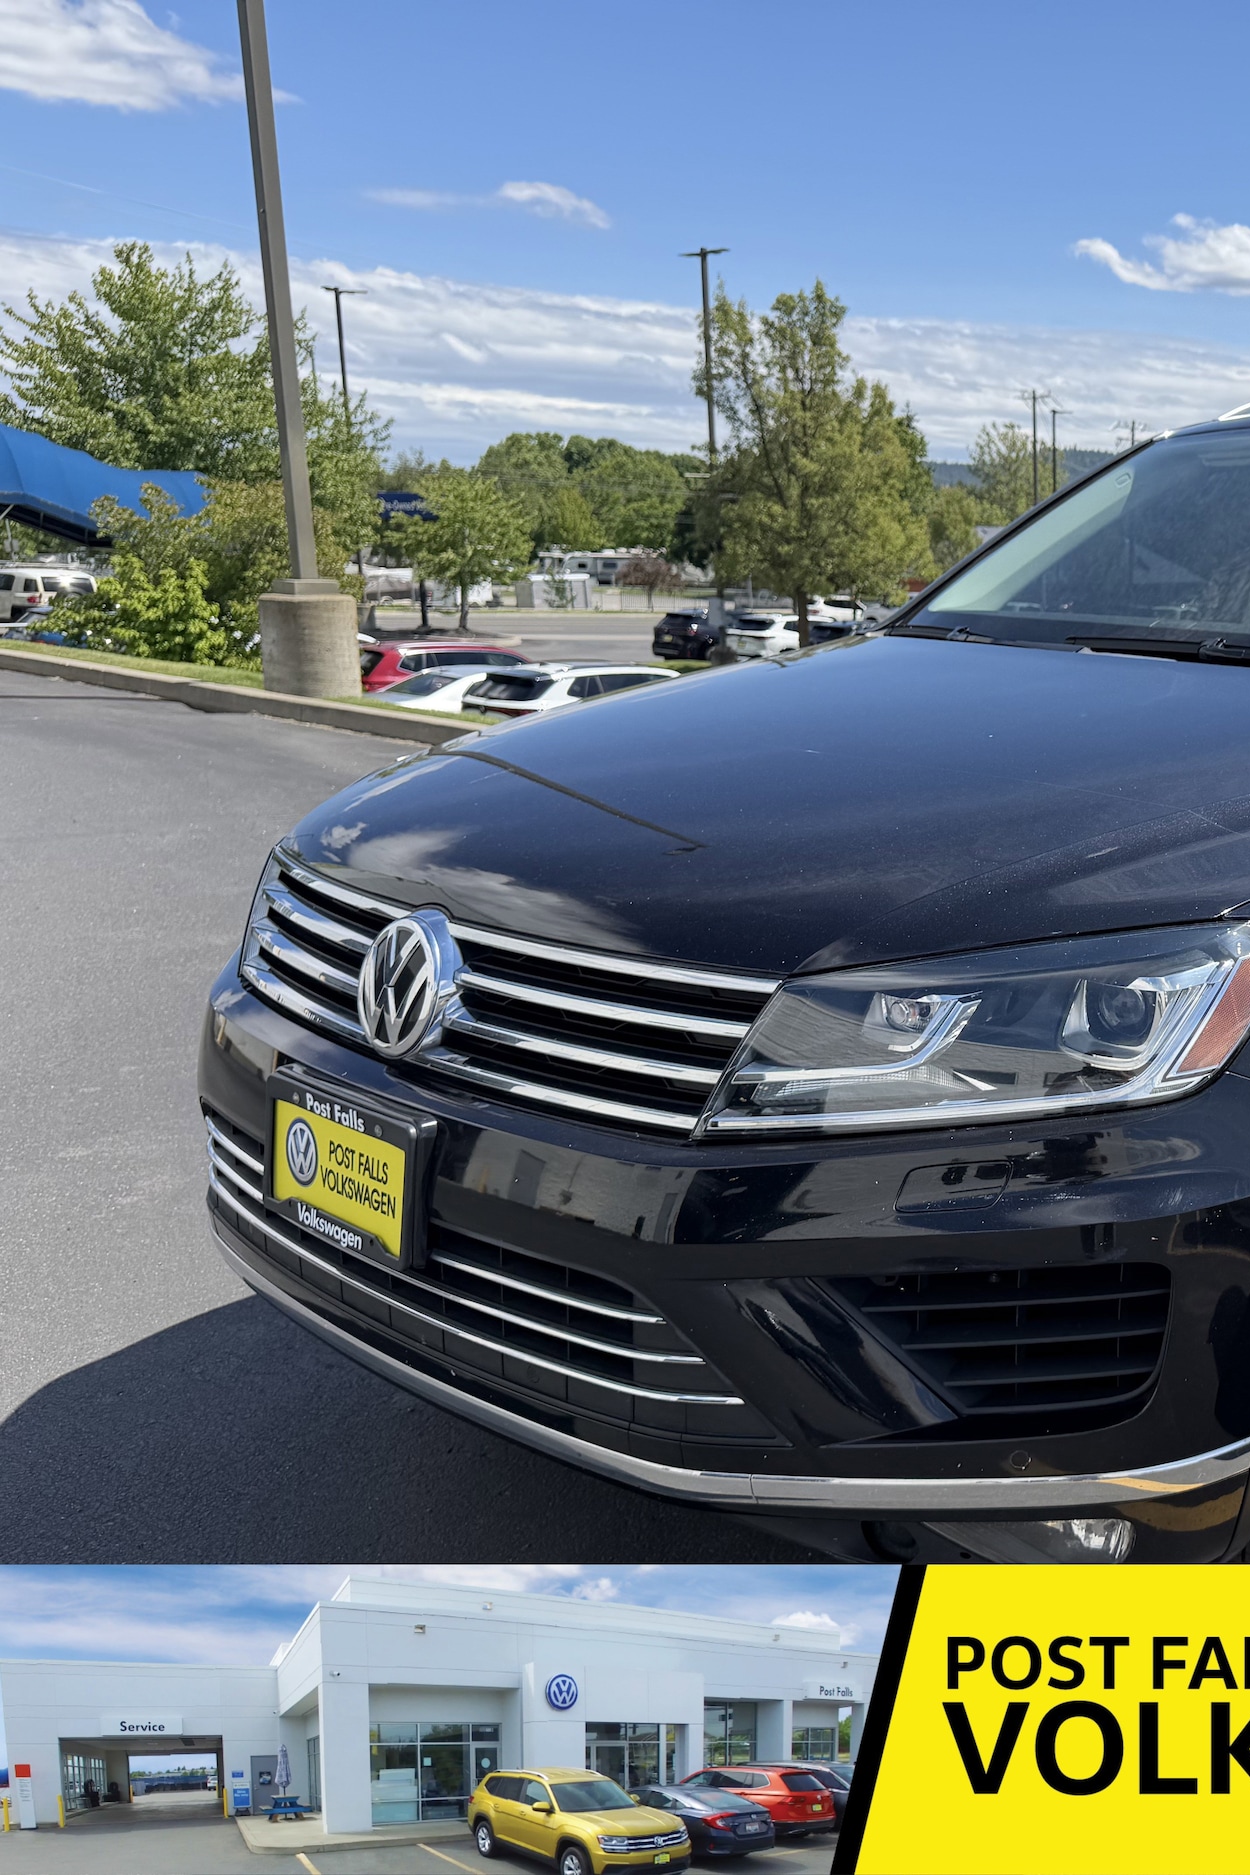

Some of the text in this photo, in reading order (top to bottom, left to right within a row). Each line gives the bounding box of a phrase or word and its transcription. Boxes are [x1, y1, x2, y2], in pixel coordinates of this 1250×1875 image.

[305, 1092, 365, 1133] Post Falls
[287, 1118, 317, 1186] VW
[328, 1139, 389, 1186] POST FALLS
[320, 1165, 396, 1219] VOLKSWAGEN
[297, 1202, 363, 1251] Volkswagen
